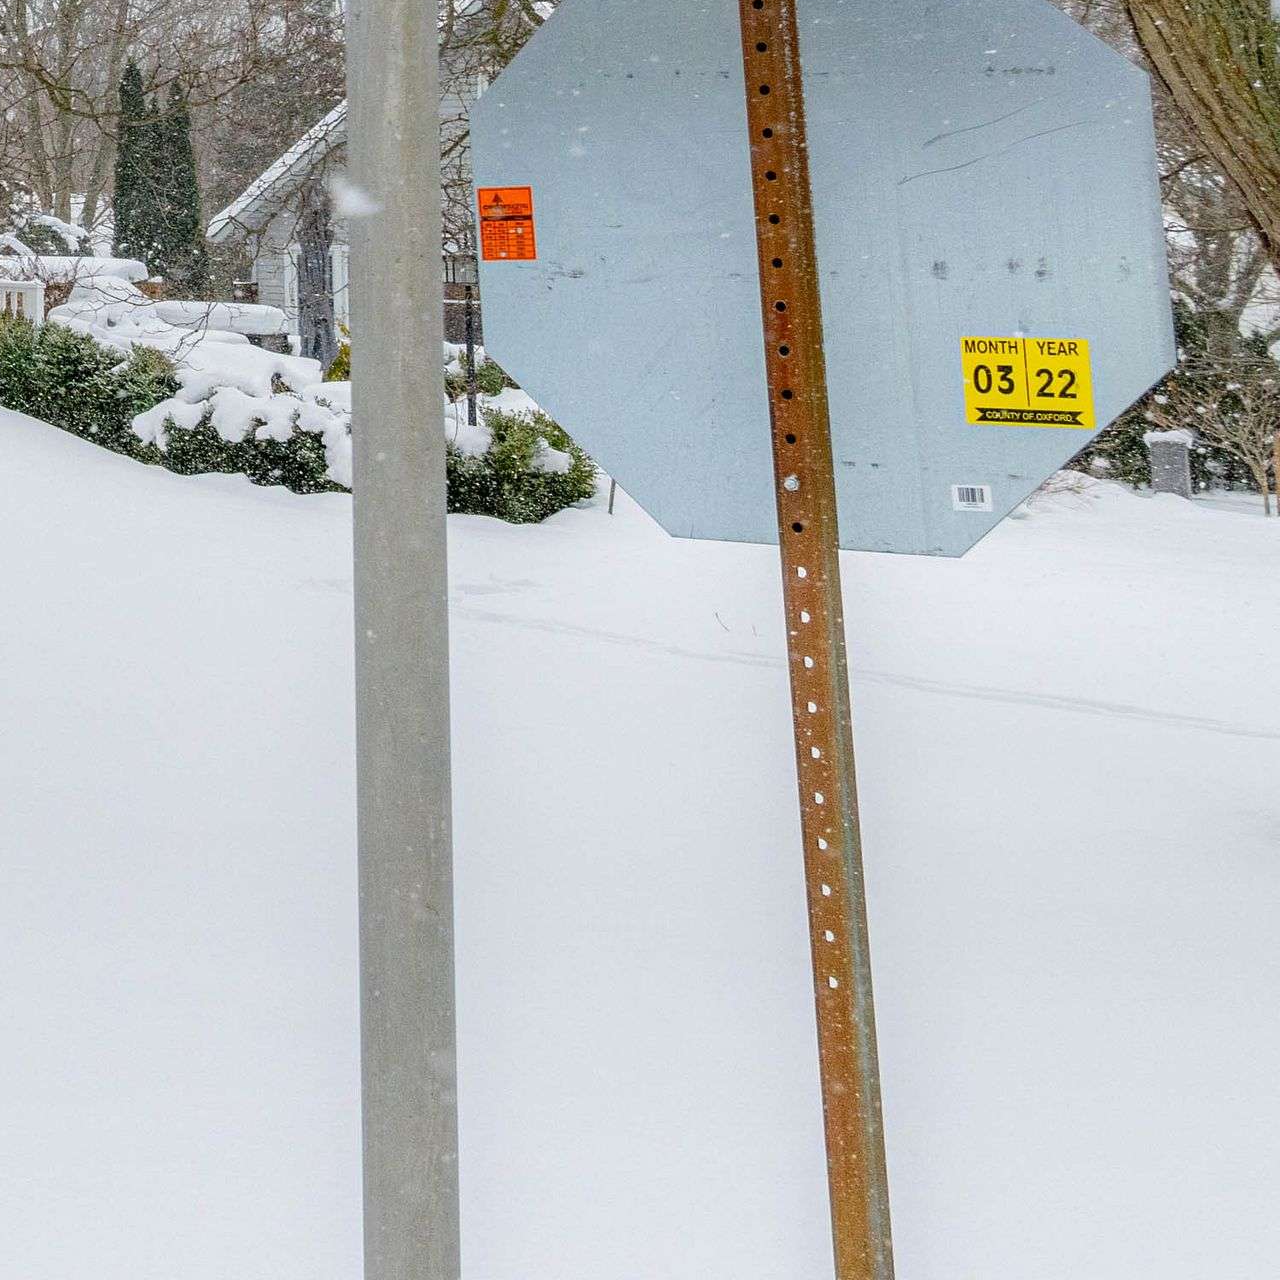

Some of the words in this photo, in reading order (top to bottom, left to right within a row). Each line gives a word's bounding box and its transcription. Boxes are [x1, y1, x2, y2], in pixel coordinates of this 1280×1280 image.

[964, 339, 1018, 355] MONTH
[1036, 340, 1079, 356] YEAR
[973, 364, 1015, 395] 03
[1035, 368, 1077, 399] 22
[985, 410, 1020, 420] COUNTY
[1022, 411, 1035, 420] OF
